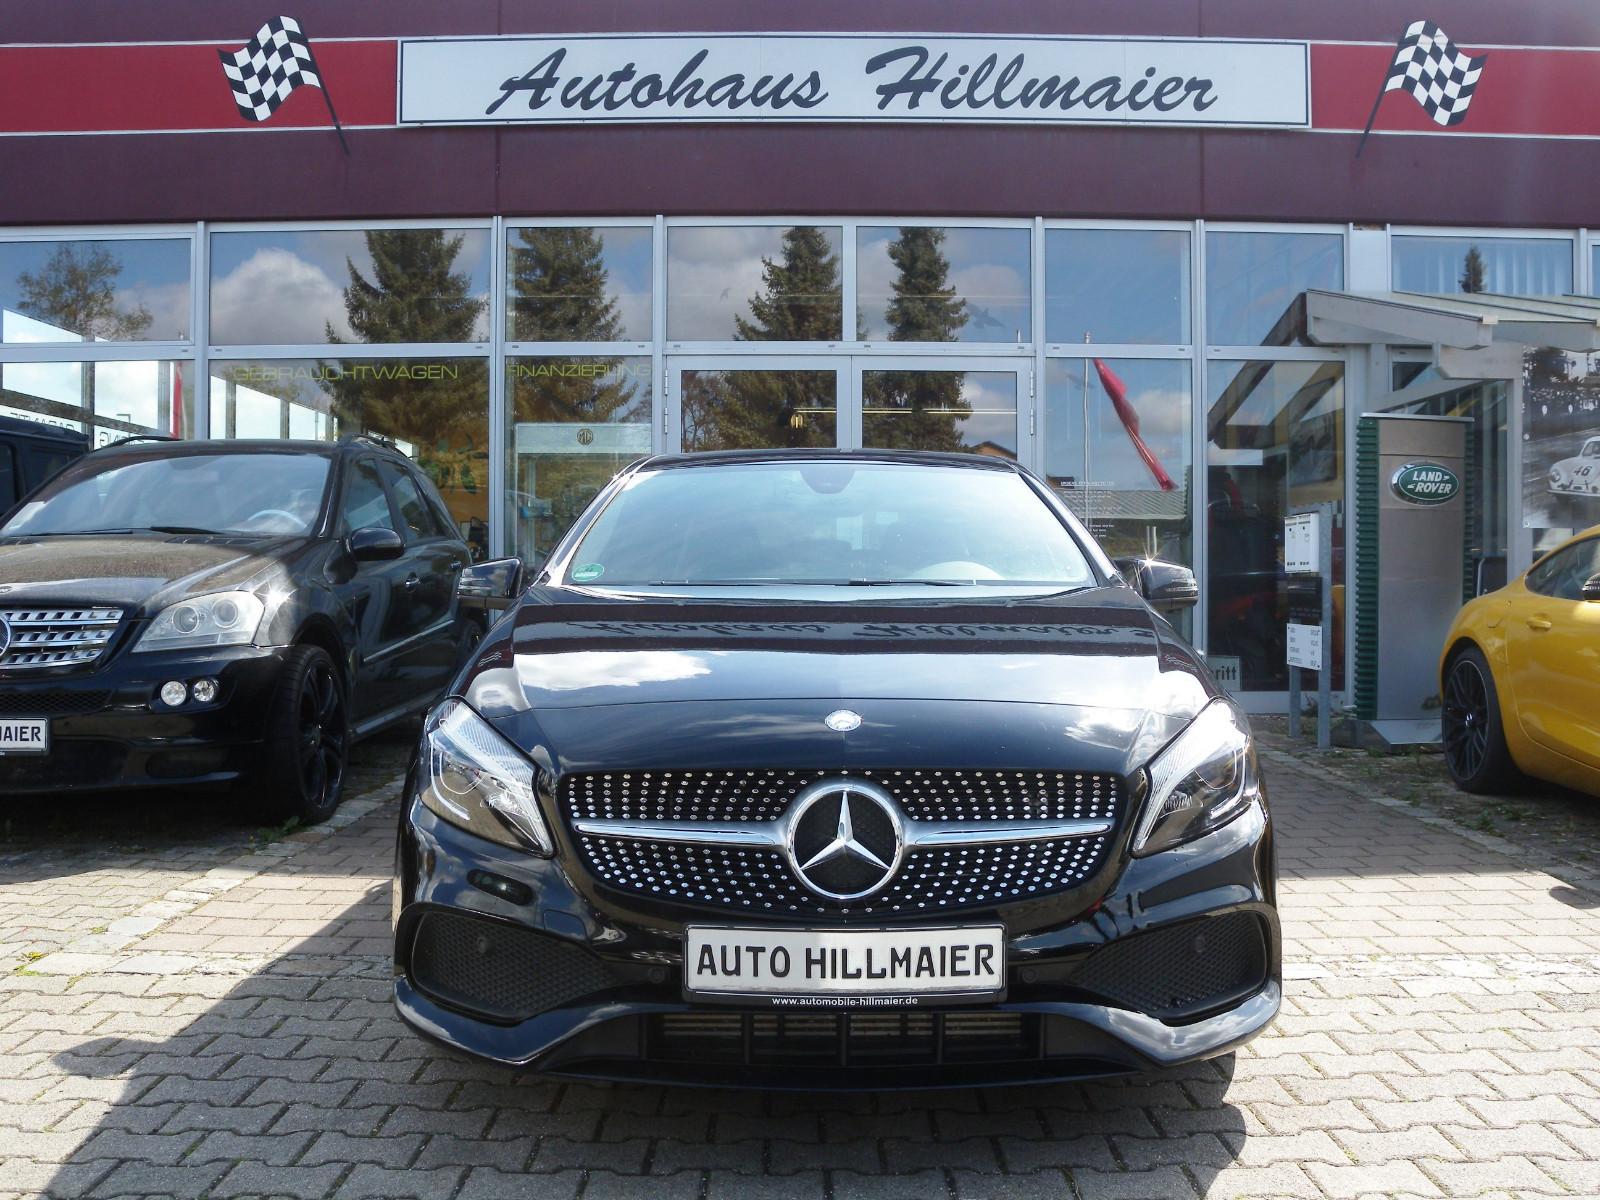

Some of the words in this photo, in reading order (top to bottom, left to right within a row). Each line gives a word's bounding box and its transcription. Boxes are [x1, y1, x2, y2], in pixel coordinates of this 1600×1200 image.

[486, 47, 828, 114] Autohaus
[864, 46, 1218, 112] Hillmaier
[233, 365, 458, 380] GEBRAUCHTWAGEN
[1413, 471, 1442, 481] LAND
[1415, 482, 1452, 494] ROVER
[0, 726, 41, 742] AIER
[696, 944, 791, 978] AUTO
[805, 944, 995, 979] HILLMAIER
[772, 996, 918, 1006] www.automobile-hillmaier.de
